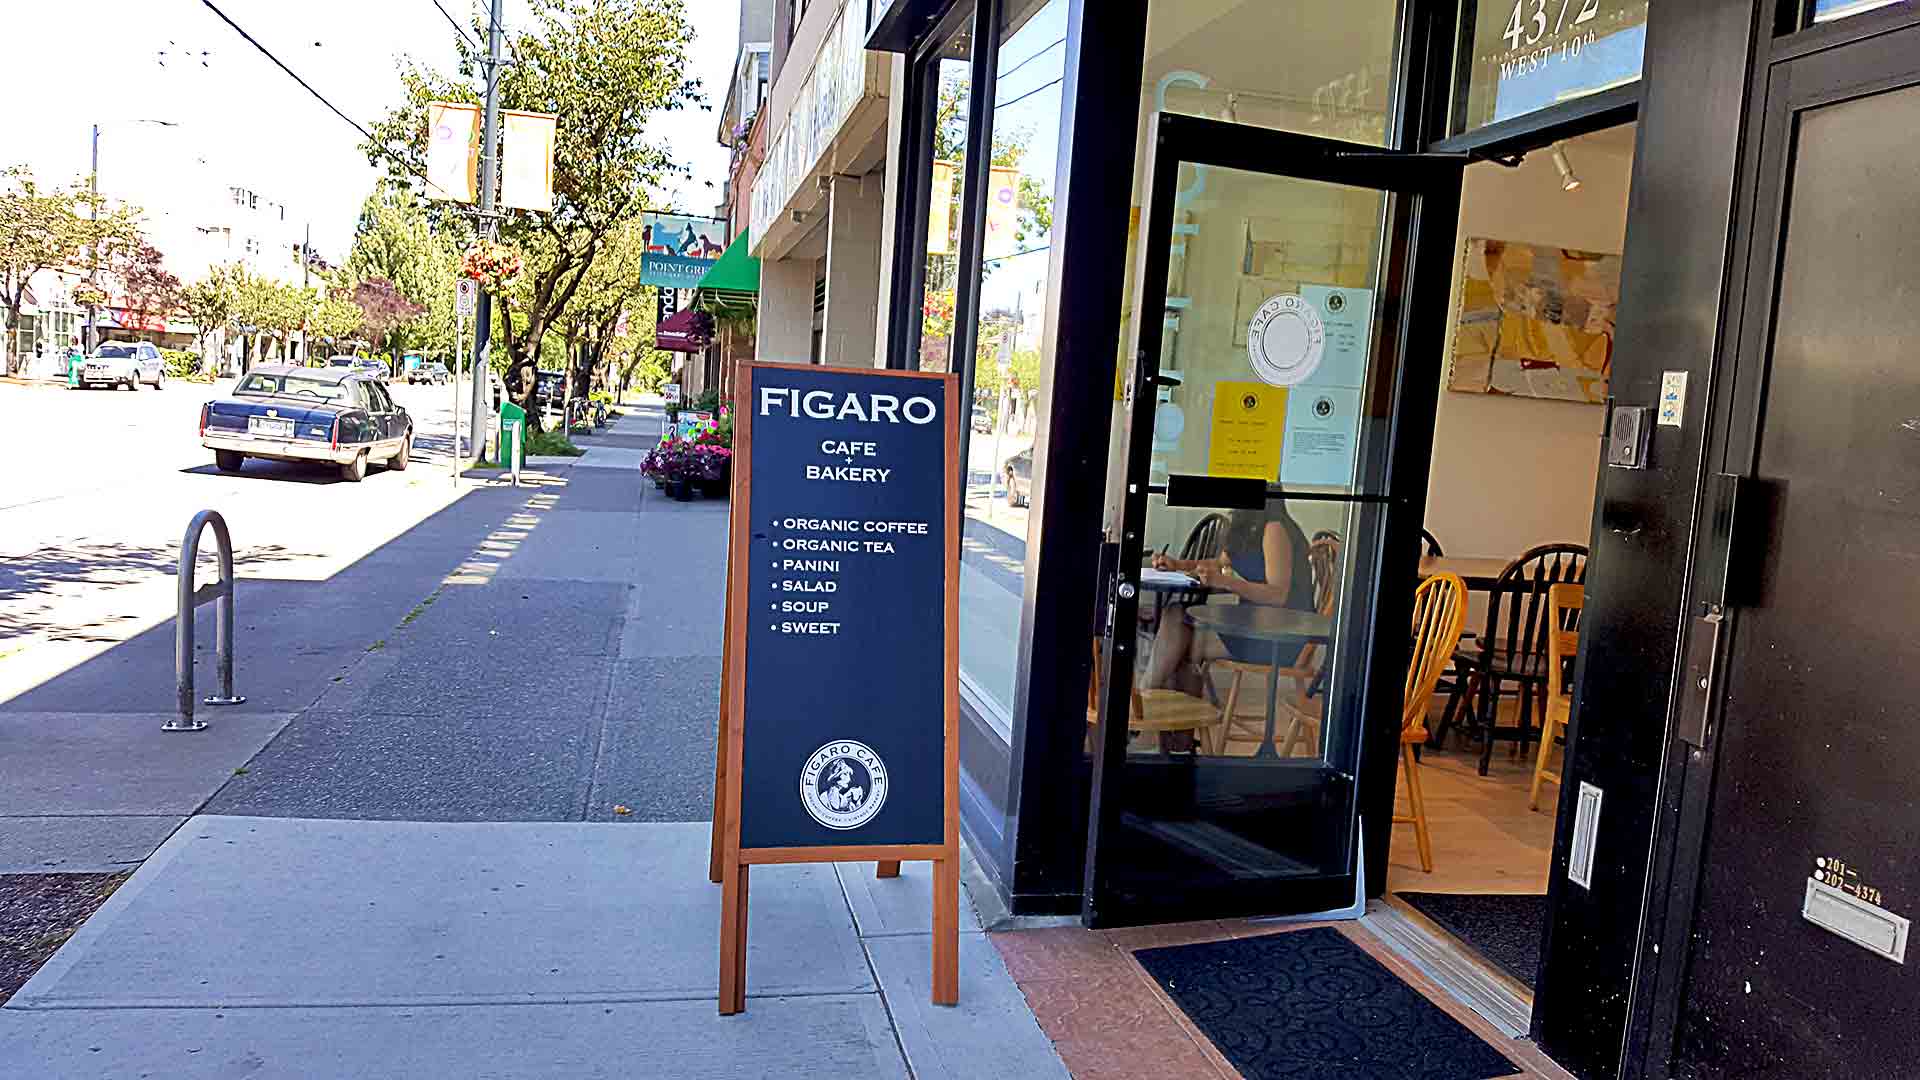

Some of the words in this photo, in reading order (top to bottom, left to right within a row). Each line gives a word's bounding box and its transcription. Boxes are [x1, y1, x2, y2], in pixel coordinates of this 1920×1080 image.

[1500, 46, 1553, 80] WEST
[1560, 28, 1596, 64] 10th
[648, 261, 684, 274] POINT
[760, 387, 937, 424] FIGARO
[821, 440, 877, 456] CAFE
[806, 465, 891, 483] BAKERY
[783, 518, 860, 532] ORGANIC
[863, 521, 928, 535] COFFEE
[783, 539, 860, 552] ORGANIC
[863, 541, 895, 554] TEA
[783, 559, 840, 572] PANINI
[782, 580, 837, 593] SALAD
[781, 601, 829, 613] SOUP
[781, 622, 841, 635] SWEET
[805, 744, 851, 787] FIGARO
[856, 749, 883, 786] CAFE
